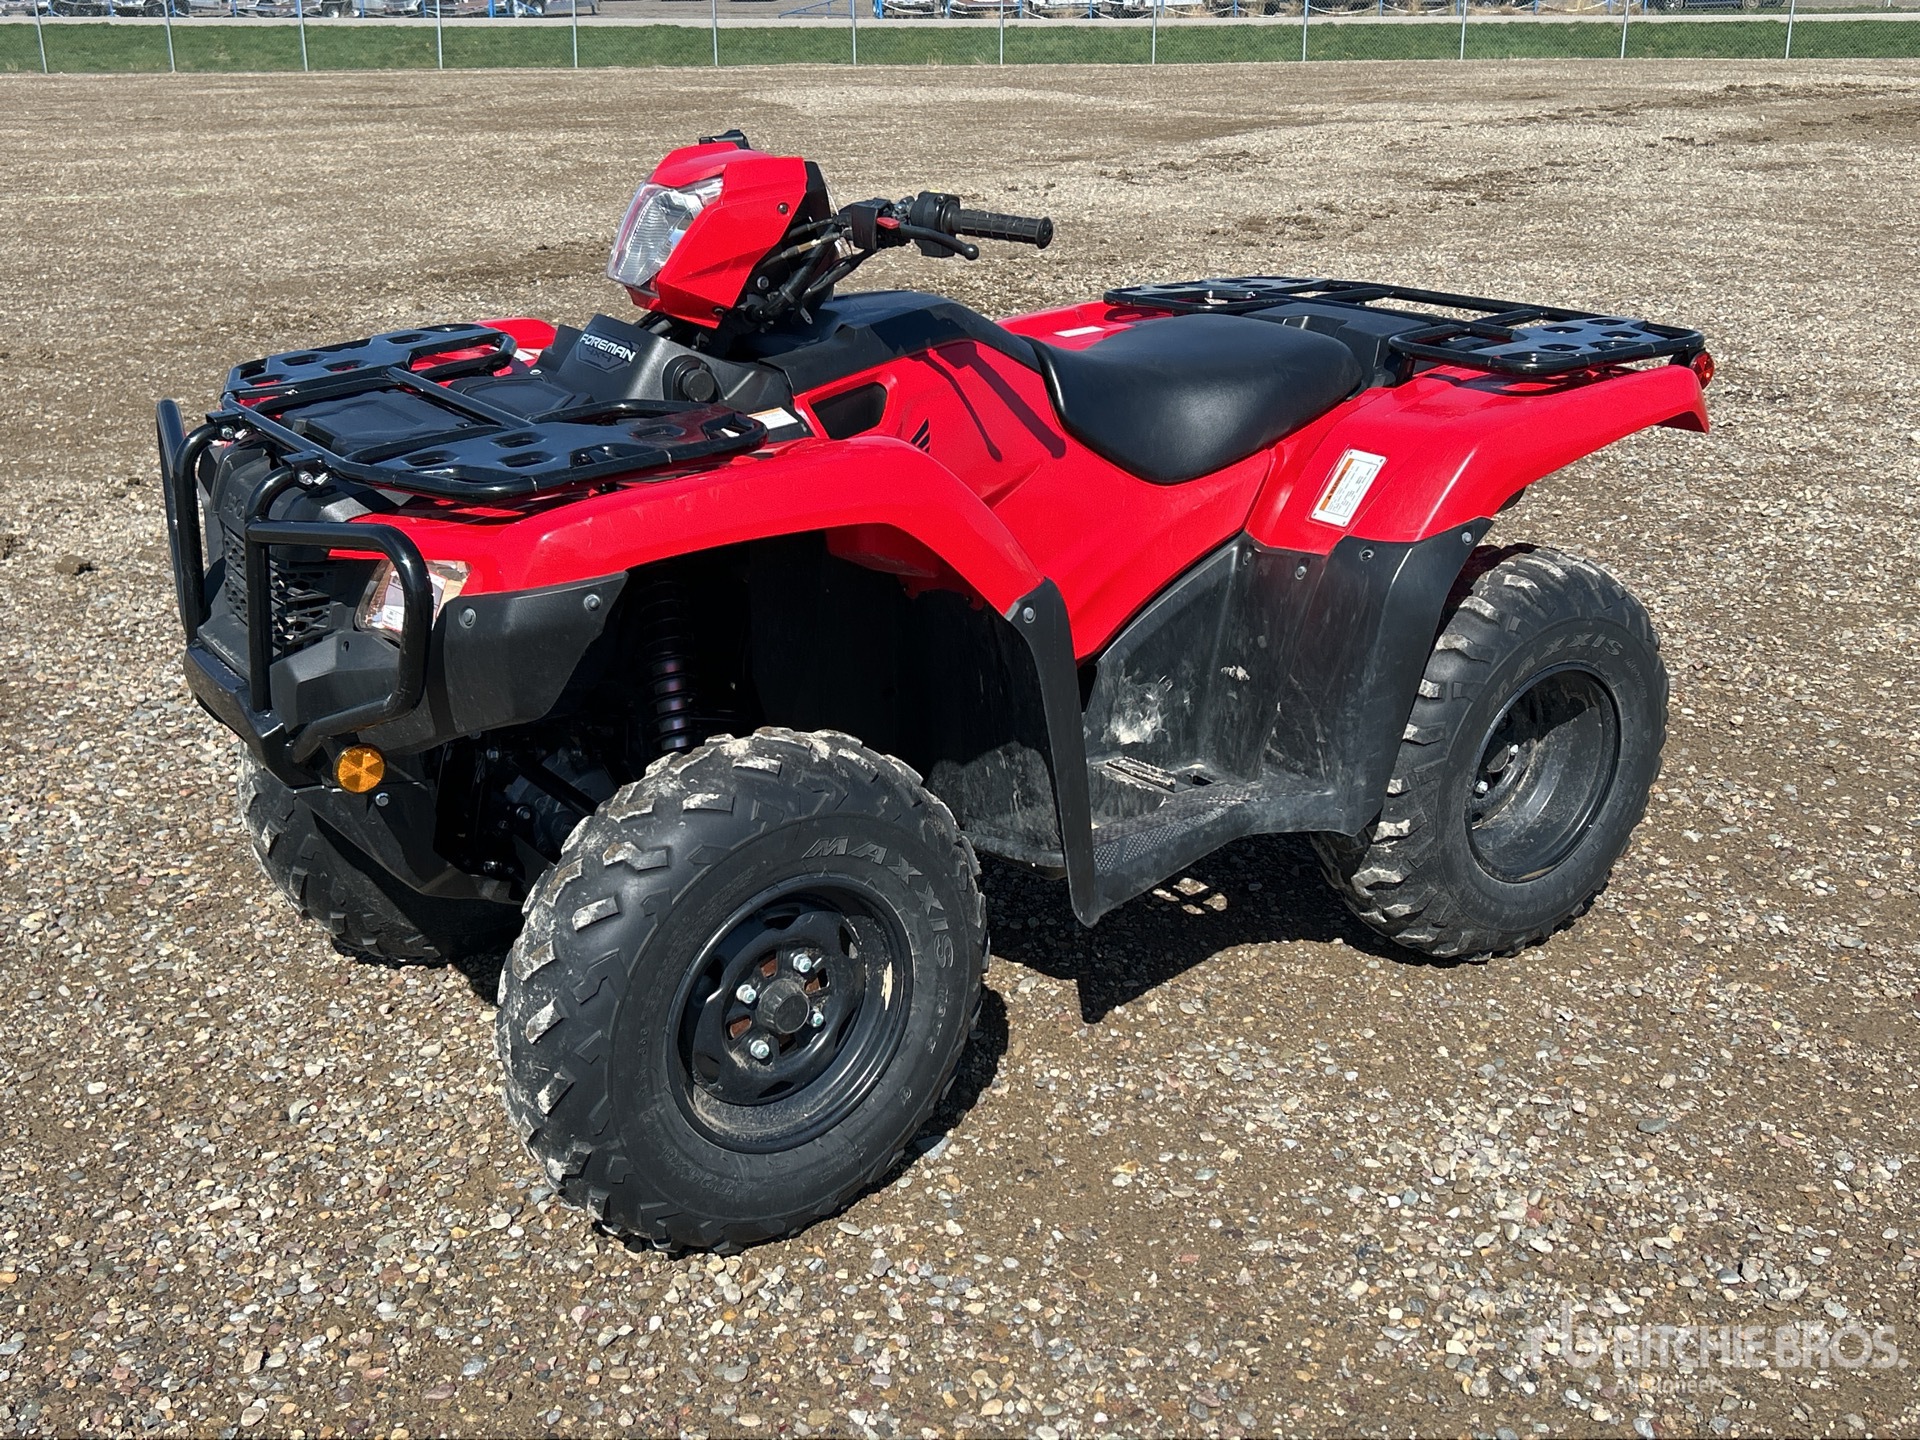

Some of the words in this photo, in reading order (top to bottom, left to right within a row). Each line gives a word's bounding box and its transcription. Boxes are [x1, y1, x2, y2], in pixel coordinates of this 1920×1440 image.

[579, 333, 637, 362] FOREMAN
[1487, 633, 1624, 717] MAXXIS
[801, 837, 954, 969] MAXXIS
